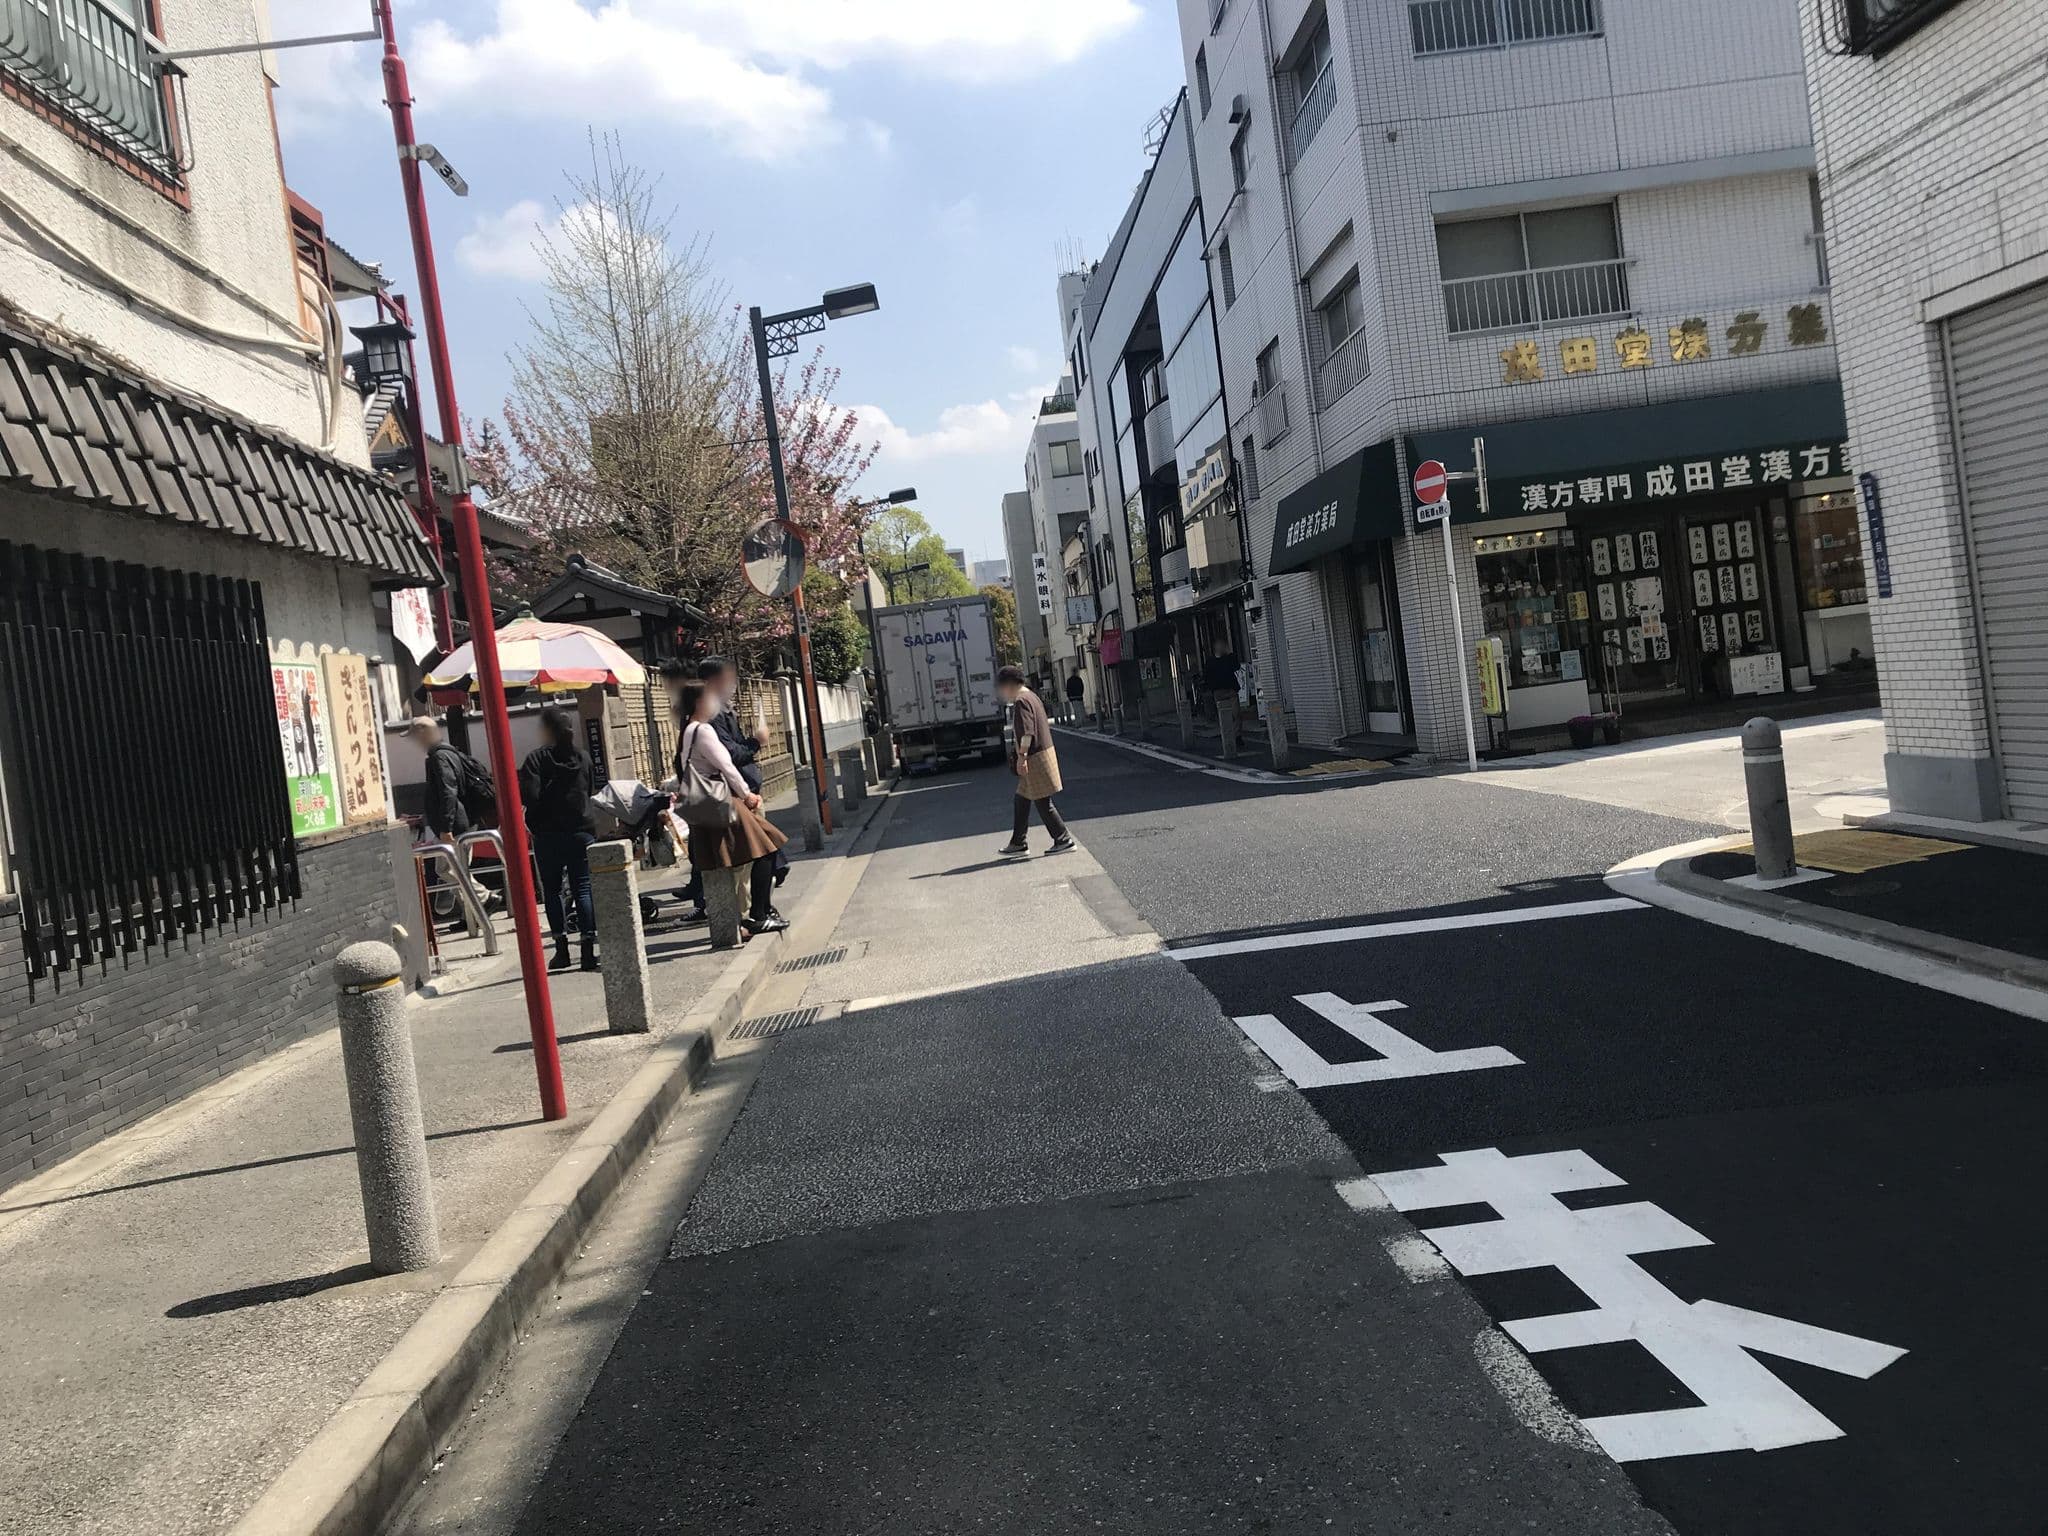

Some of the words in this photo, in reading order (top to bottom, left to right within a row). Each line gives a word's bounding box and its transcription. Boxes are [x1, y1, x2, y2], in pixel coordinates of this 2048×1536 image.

[1500, 302, 1828, 385] 成田堂漢方薬
[1521, 474, 1632, 512] 漢方専門
[1286, 500, 1339, 549] 成田堂漢方薬局
[1034, 558, 1051, 609] 清水眼科
[904, 629, 968, 647] SAGAWA
[1748, 614, 1761, 640] 胆石
